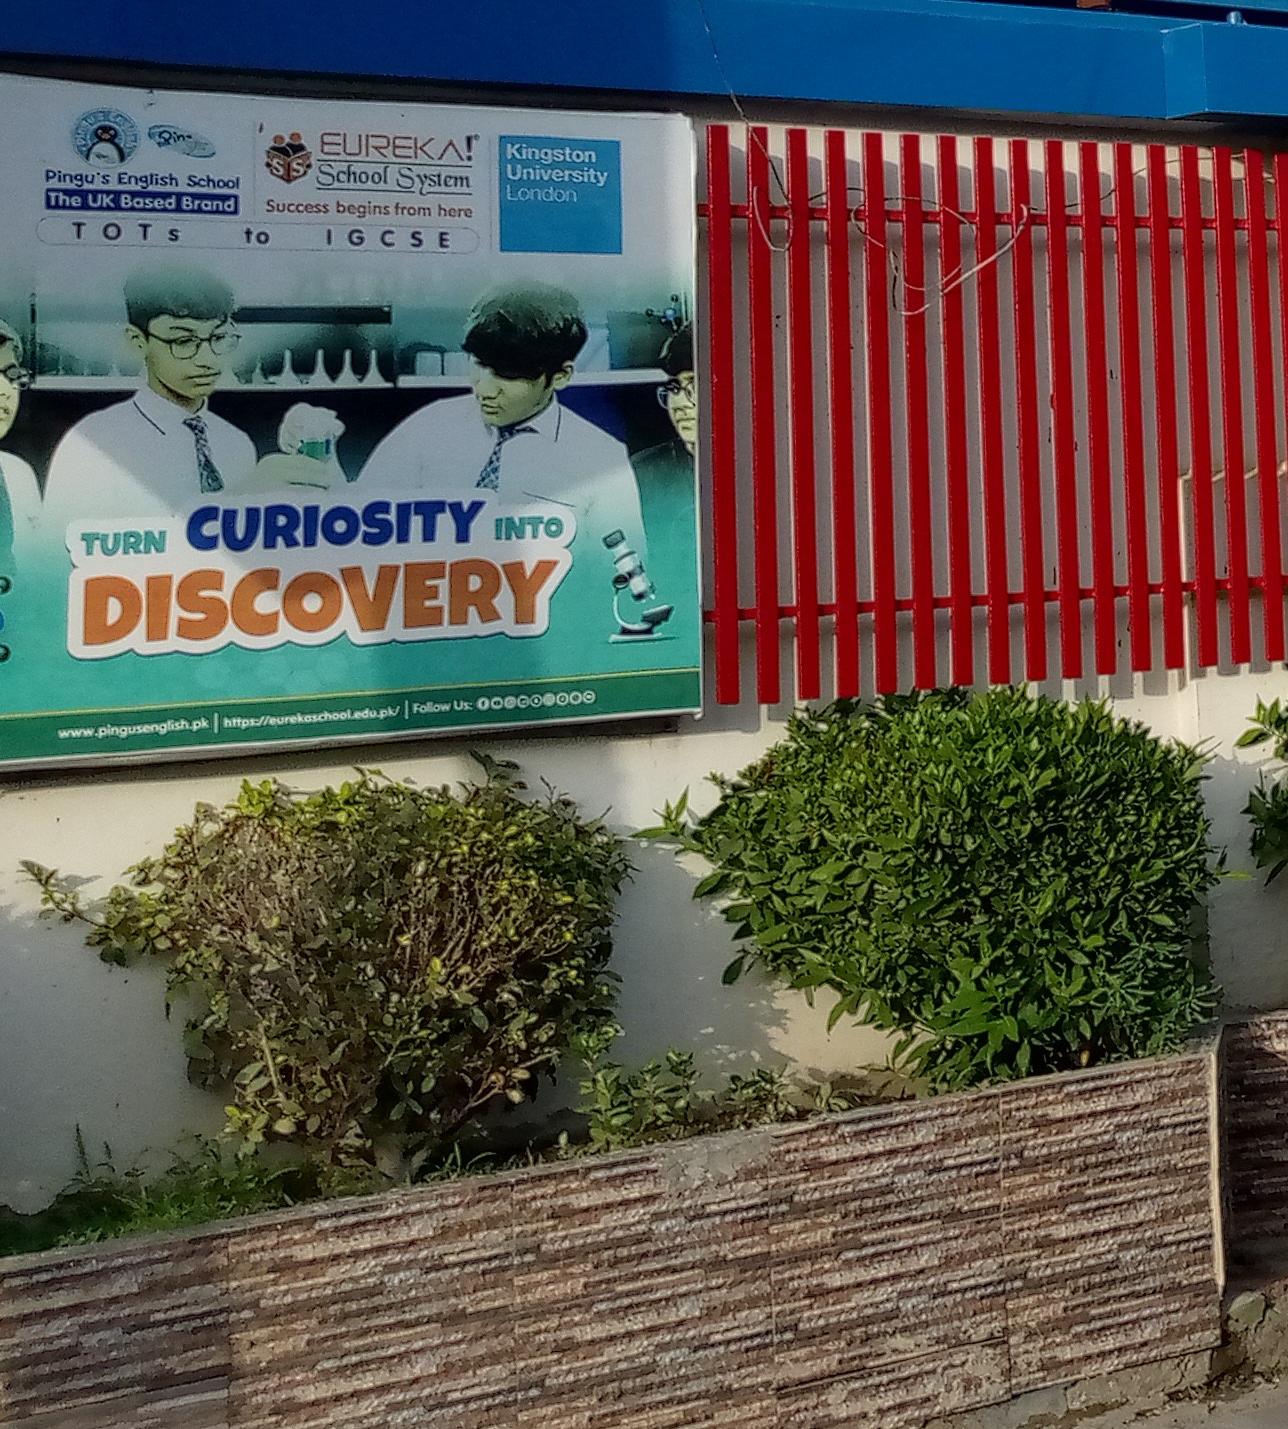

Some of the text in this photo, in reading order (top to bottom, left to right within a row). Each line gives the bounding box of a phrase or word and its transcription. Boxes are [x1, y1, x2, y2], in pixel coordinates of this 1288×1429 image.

[506, 143, 596, 164] Kingston
[45, 170, 240, 189] Pingu's English School
[317, 164, 470, 196] School System
[506, 164, 608, 187] University
[48, 192, 235, 212] The UK Based Brand
[506, 184, 577, 202] London
[266, 199, 473, 218] Success begins from here
[244, 227, 270, 245] to
[81, 499, 563, 556] TURN CURIOSITY INTO
[82, 558, 560, 646] DISCOVERY
[58, 718, 209, 739] www.pingusenglish.pk
[413, 701, 451, 714] Follow
[453, 699, 473, 711] Us:
